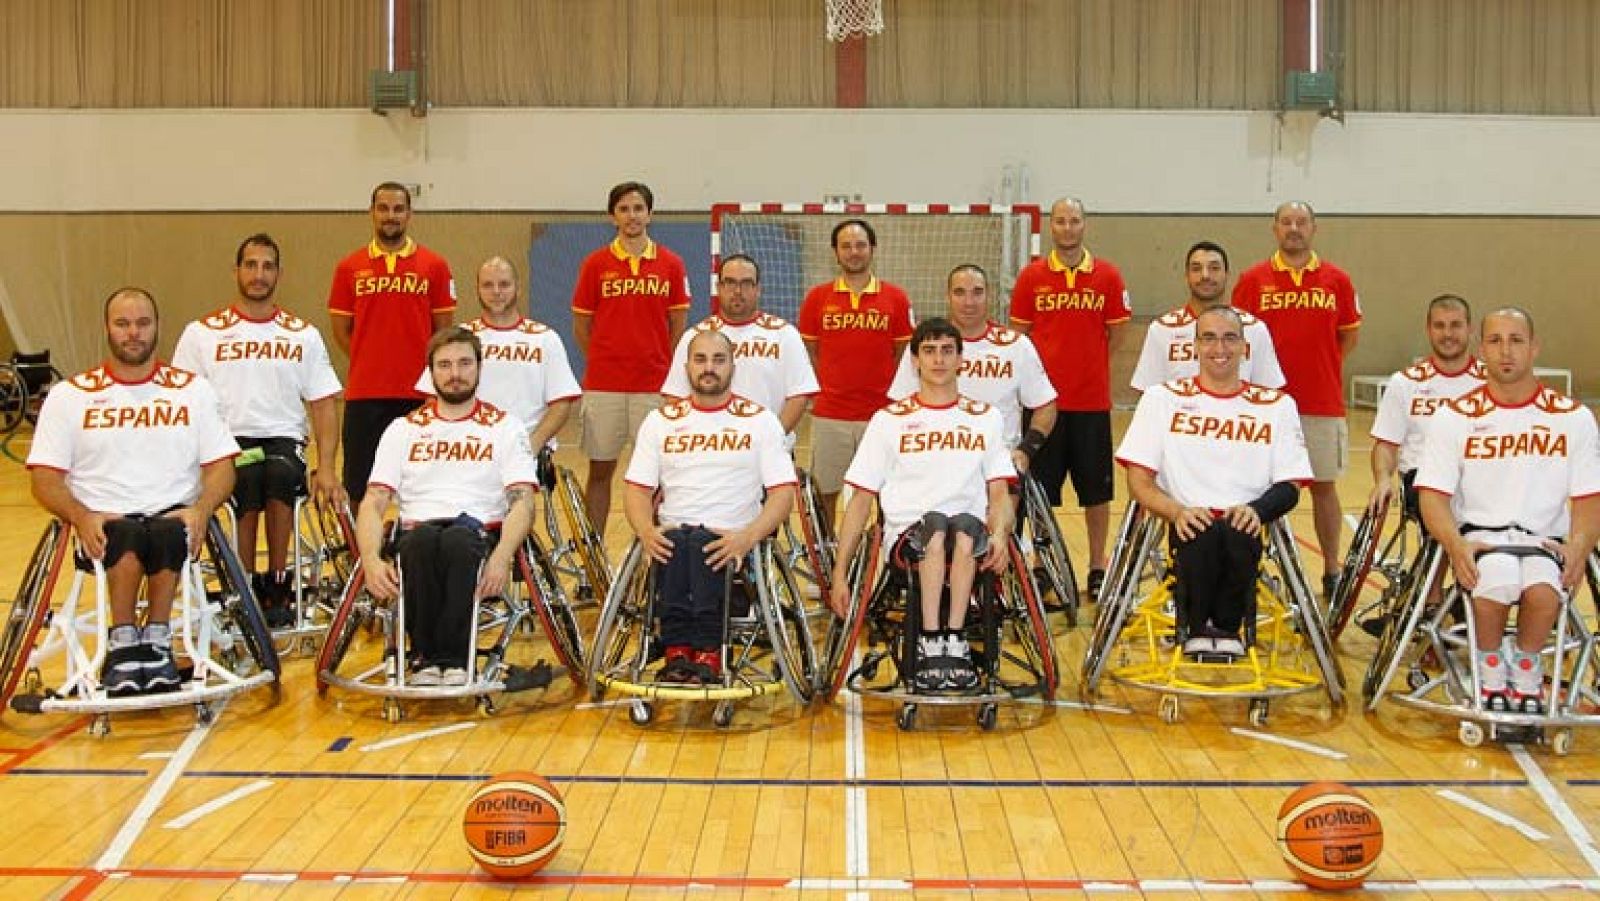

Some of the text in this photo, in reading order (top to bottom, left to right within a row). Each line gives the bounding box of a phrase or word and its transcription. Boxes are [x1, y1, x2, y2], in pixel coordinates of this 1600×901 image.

[355, 273, 428, 296] ESPAÑA
[602, 274, 670, 297] ESPAÑA
[1036, 288, 1105, 312] ESPAÑA
[1260, 287, 1336, 310] ESPAÑA
[822, 308, 888, 331] ESPAÑA
[215, 335, 303, 363] ESPAÑA
[481, 341, 543, 363] PAÑA
[955, 354, 1013, 378] PAÑA
[83, 399, 190, 429] ESPAÑA
[664, 427, 751, 453] ESPAÑA
[900, 425, 986, 453] ESPAÑA
[1170, 412, 1272, 444] ESPAÑA
[409, 435, 493, 462] ESPAÑA
[1465, 425, 1567, 460] ESPAÑA
[476, 795, 542, 814] molten
[1305, 808, 1371, 830] molten
[495, 829, 525, 846] FIBA
